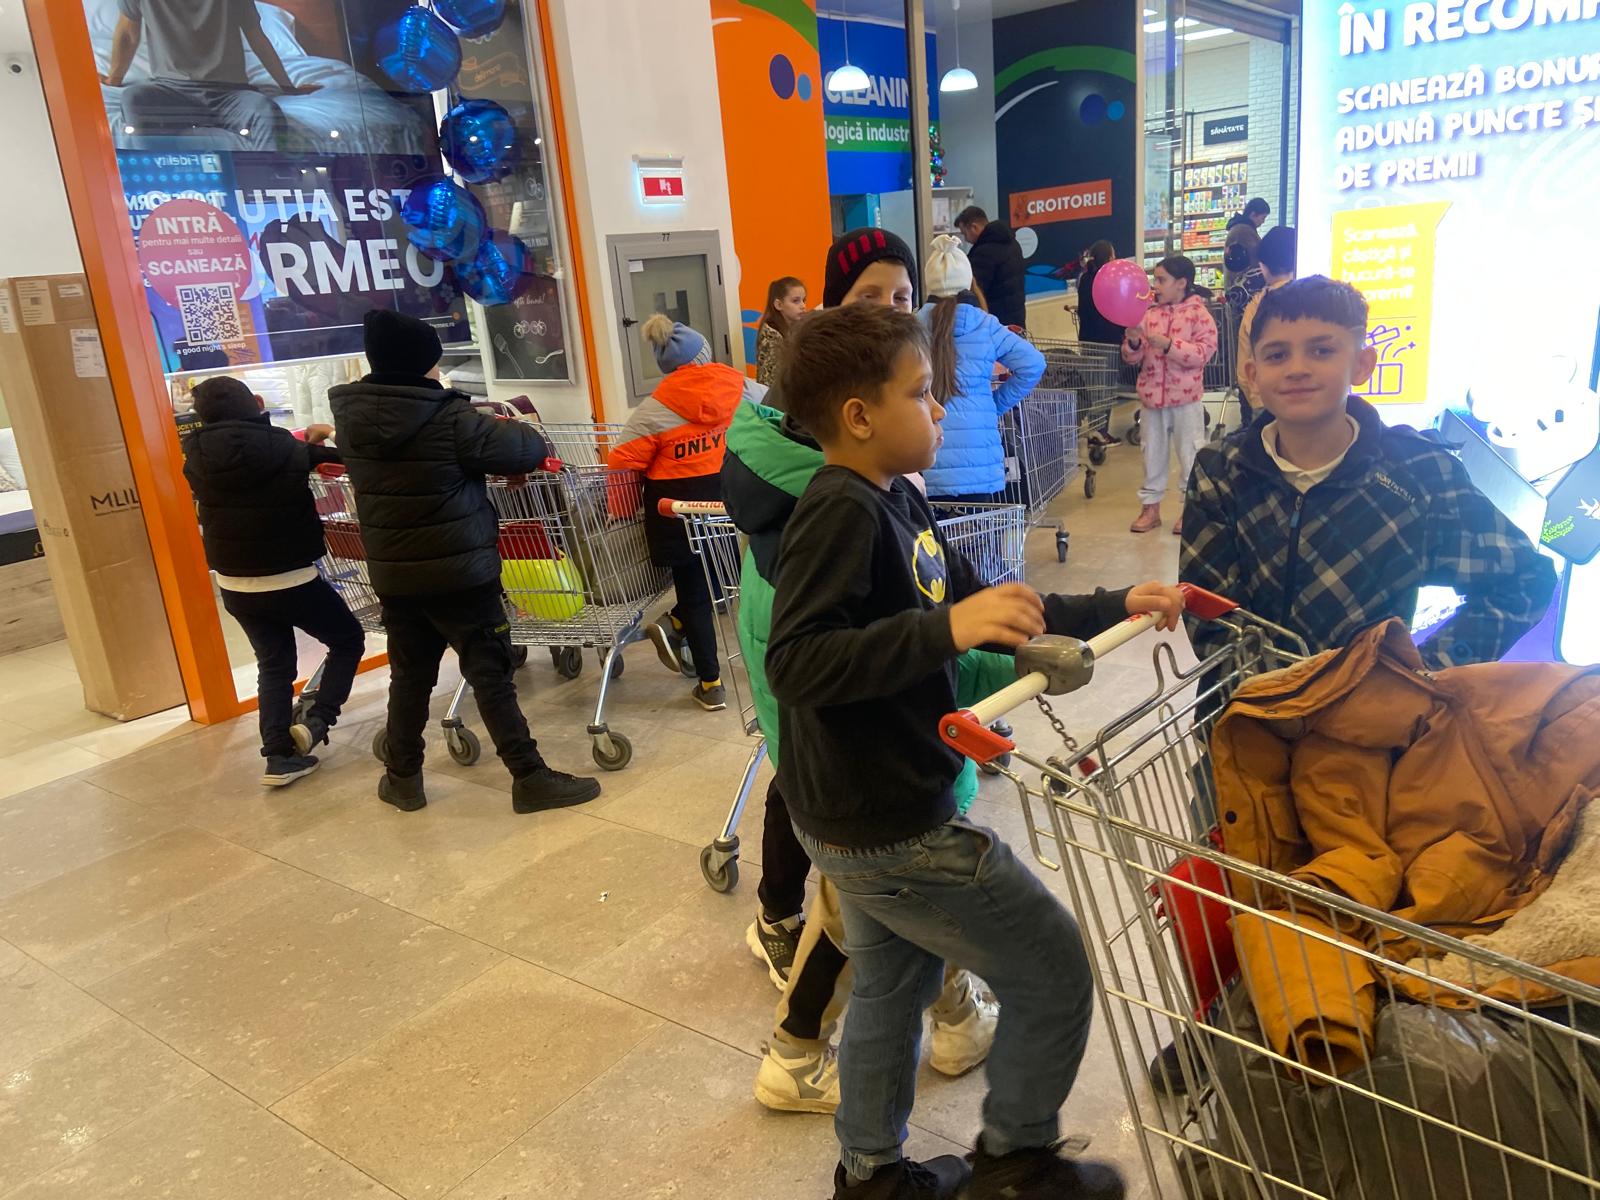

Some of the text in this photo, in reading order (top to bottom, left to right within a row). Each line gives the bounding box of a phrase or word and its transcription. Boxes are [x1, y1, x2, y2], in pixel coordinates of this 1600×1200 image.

[1337, 3, 1386, 56] ÎN
[1337, 64, 1485, 114] SCANEAZĂ
[1210, 124, 1245, 136] SĂNĂTATE
[1335, 112, 1435, 152] ADUNĂ
[1444, 99, 1564, 139] PUNCTE
[1335, 152, 1477, 191] DE PREMII
[1027, 192, 1106, 214] CROITORIE
[155, 211, 223, 235] INTRĂ
[142, 238, 171, 248] pentru
[173, 237, 190, 245] mai
[191, 236, 215, 244] multe
[217, 234, 242, 243] detalii
[661, 232, 671, 241] 77
[187, 248, 203, 256] sau
[147, 253, 247, 276] SCANEAZĂ
[182, 346, 201, 355] good
[202, 343, 227, 353] night's
[227, 342, 247, 350] sleep
[674, 433, 722, 459] ONLY
